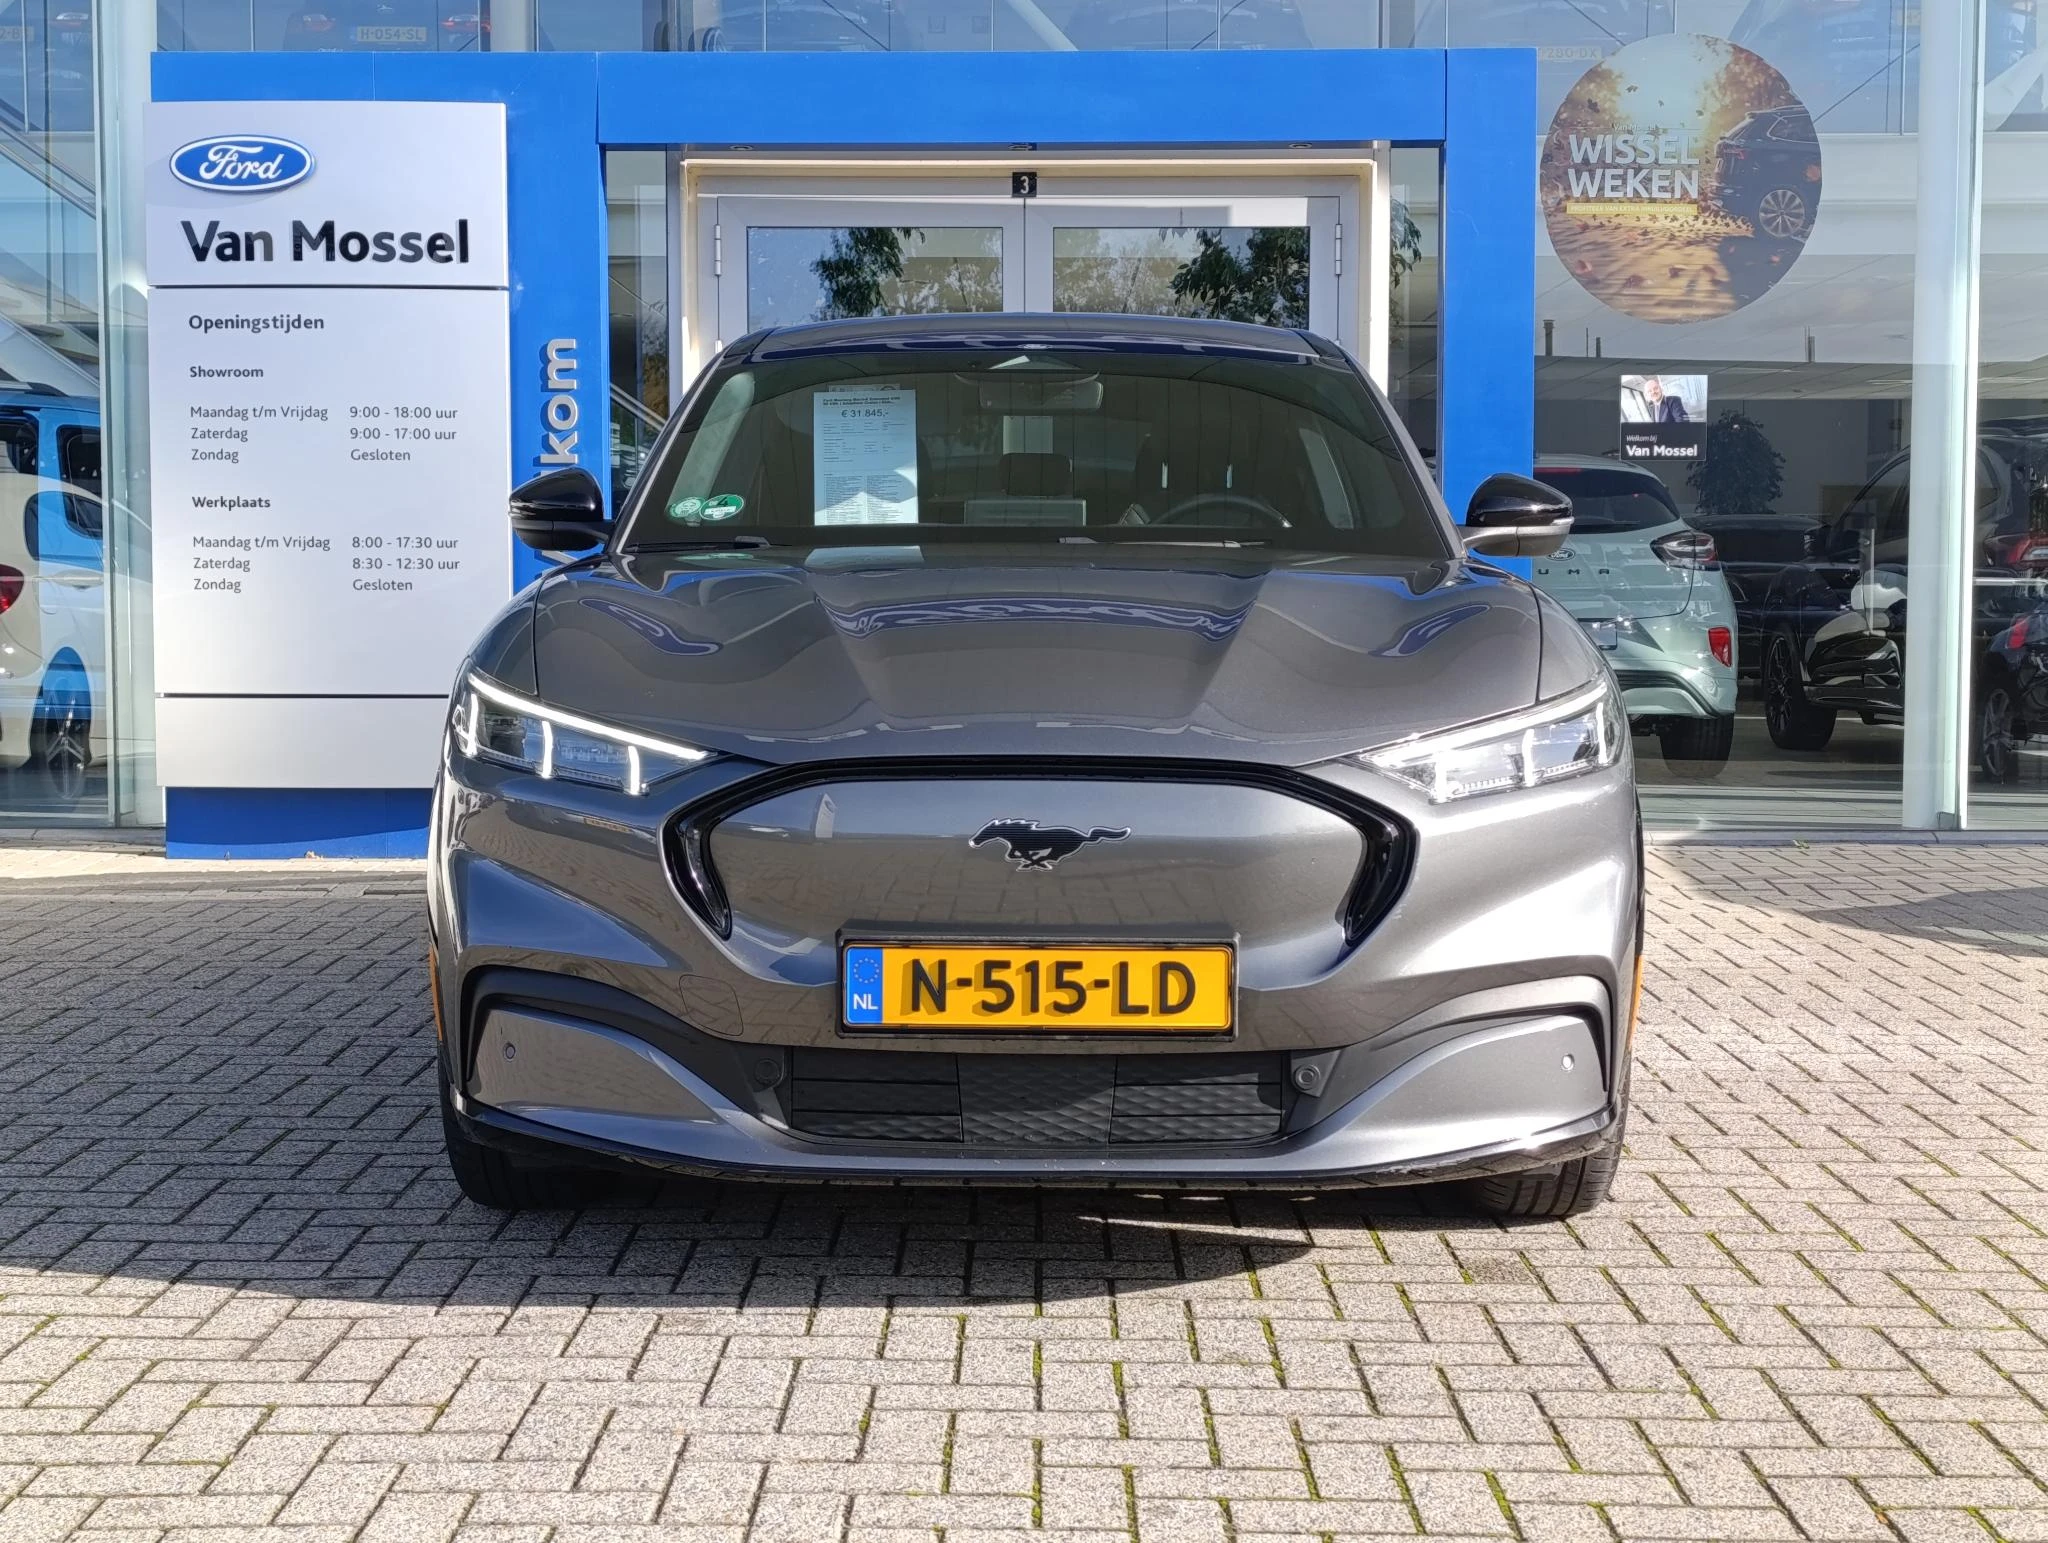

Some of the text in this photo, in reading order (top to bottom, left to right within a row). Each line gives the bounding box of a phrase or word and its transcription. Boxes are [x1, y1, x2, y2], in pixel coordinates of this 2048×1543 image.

[360, 28, 424, 41] H-054-SL
[1569, 133, 1700, 165] WISSEL
[199, 144, 285, 180] Ford
[1020, 175, 1030, 194] 3
[1568, 168, 1699, 199] WEKEN
[181, 218, 469, 264] Van Mossel
[188, 313, 325, 335] Openingstijden
[189, 365, 264, 379] Showroom
[190, 405, 329, 422] Maandag t/m Vrijdag
[349, 405, 381, 419] 9:00
[393, 405, 432, 419] 18:00
[435, 409, 458, 419] uur
[841, 409, 848, 418] €
[191, 426, 249, 443] Zaterdag
[349, 426, 381, 440] 9:00
[394, 426, 431, 440] 17:00
[434, 430, 457, 440] uur
[1626, 434, 1650, 442] Welkom
[191, 448, 240, 465] Zondag
[350, 448, 411, 461] Gesloten
[1626, 443, 1698, 457] Van Mossel
[191, 495, 271, 512] Werkplaats
[193, 535, 331, 552] Maandag t/m Vrijdag
[351, 535, 383, 549] 8:00
[396, 535, 434, 549] 17:30
[436, 539, 459, 549] uur
[1550, 549, 1569, 559] Ford
[193, 556, 251, 573] Zaterdag
[352, 556, 383, 570] 8:30
[396, 556, 434, 570] 12:30
[437, 560, 461, 570] uur
[193, 577, 242, 594] Zondag
[352, 578, 413, 591] Gesloten
[910, 958, 1196, 1015] N-515-LD
[853, 993, 879, 1011] NL
